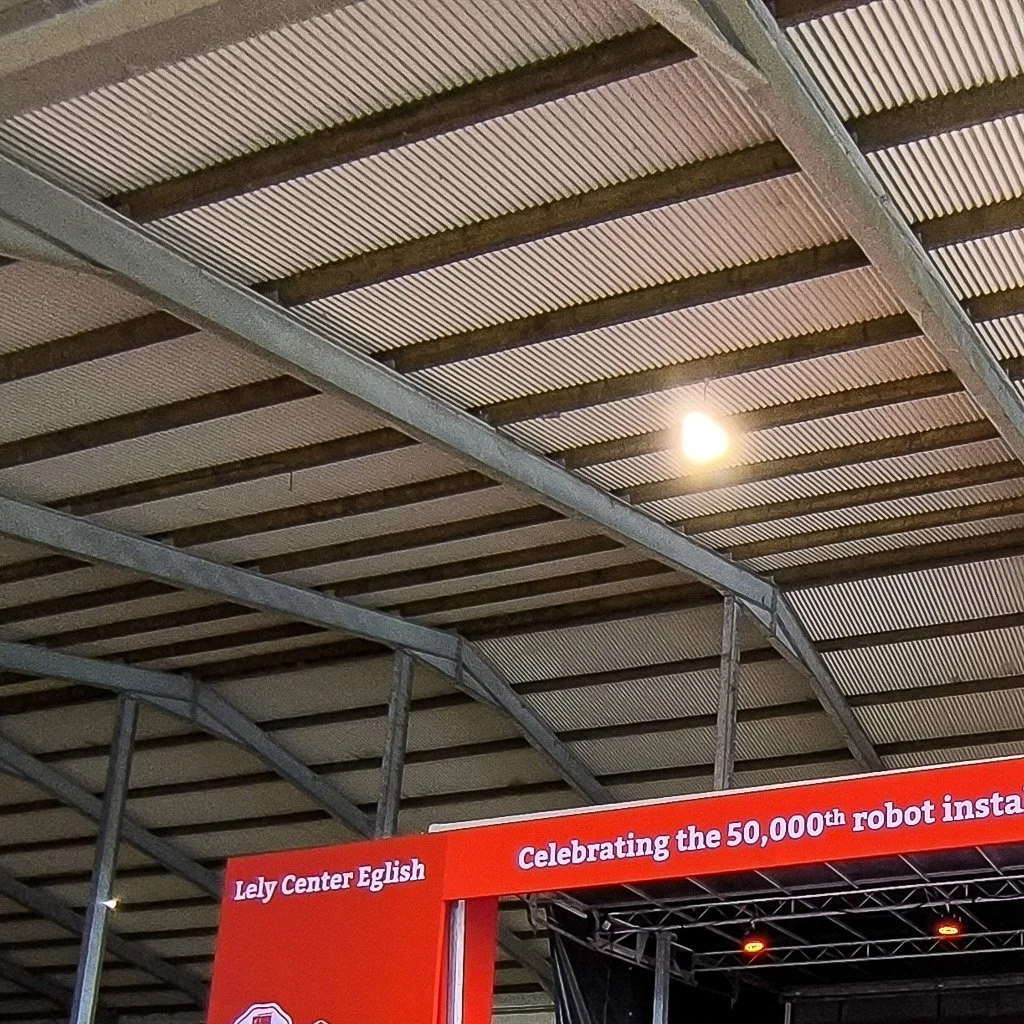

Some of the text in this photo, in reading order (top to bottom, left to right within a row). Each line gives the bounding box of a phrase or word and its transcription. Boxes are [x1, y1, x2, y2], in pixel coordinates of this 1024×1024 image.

[518, 831, 670, 869] Celebrating
[675, 826, 721, 852] the
[726, 808, 846, 848] 50,000th
[852, 801, 936, 832] robot
[233, 857, 426, 904] Lely Center Eglish
